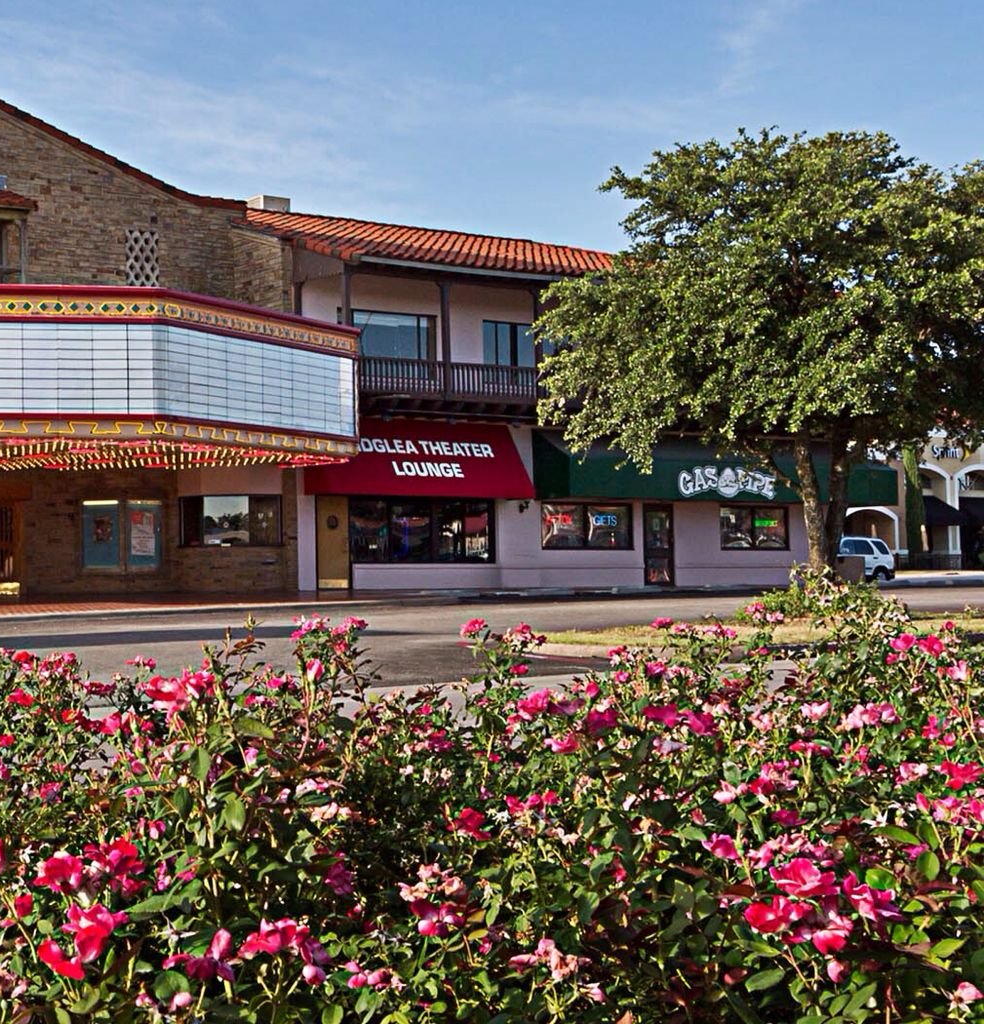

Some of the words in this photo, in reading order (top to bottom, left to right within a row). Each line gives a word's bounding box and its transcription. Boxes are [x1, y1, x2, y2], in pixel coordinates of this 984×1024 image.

[358, 438, 419, 455] DGLEA
[418, 440, 495, 458] THEATER
[392, 461, 465, 478] LOUNGE
[679, 467, 718, 496] GAS
[736, 468, 776, 499] PIPE
